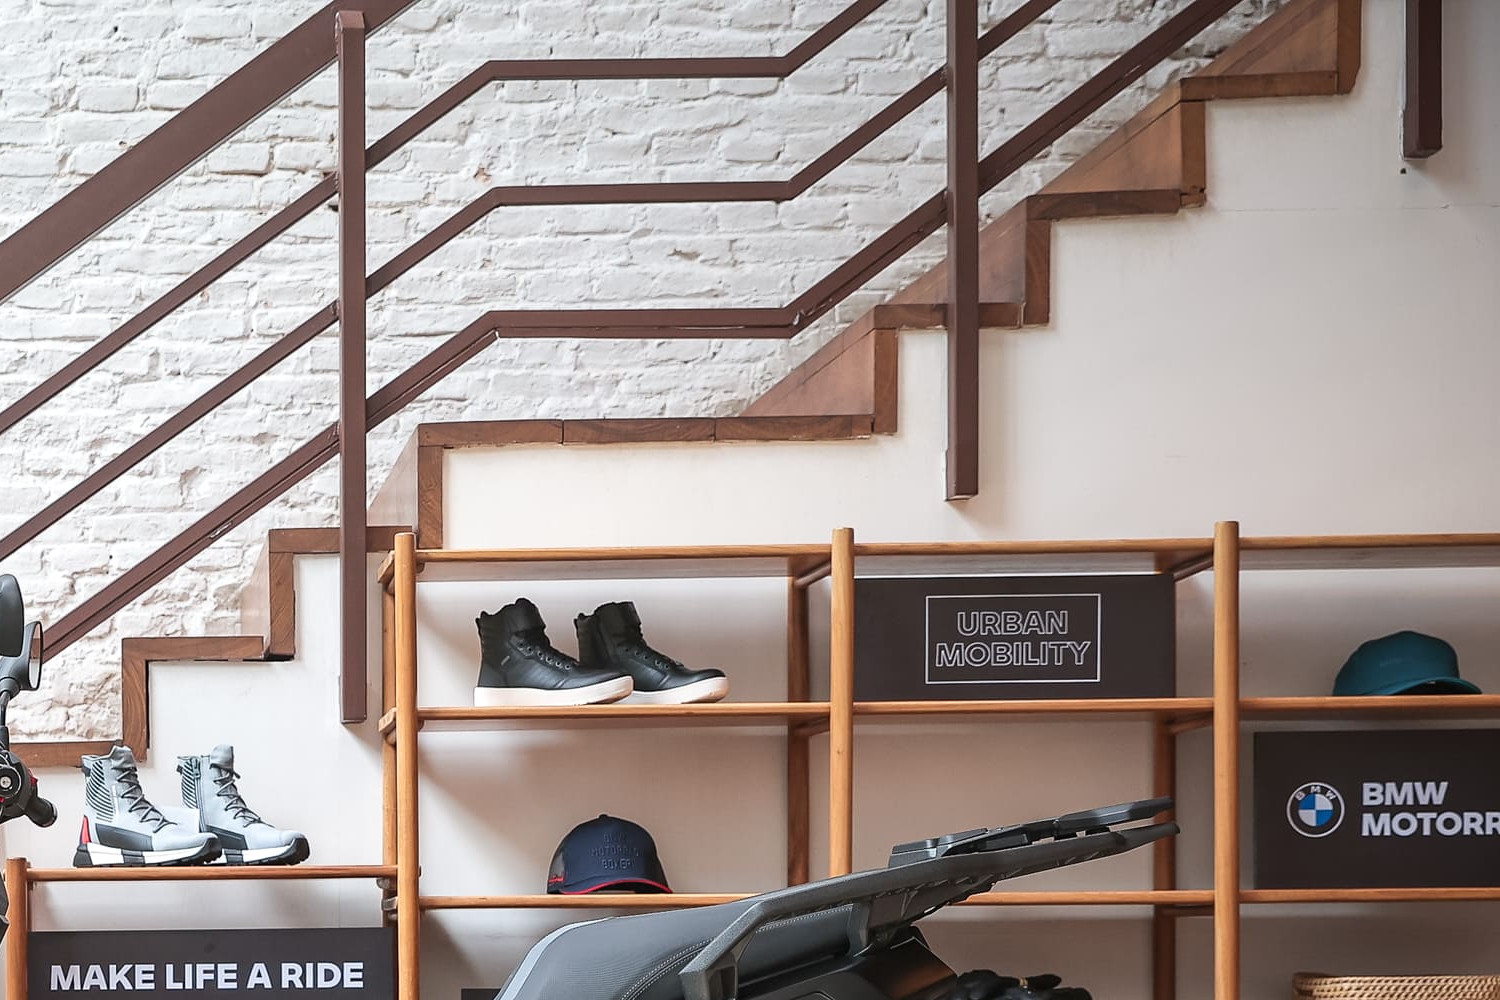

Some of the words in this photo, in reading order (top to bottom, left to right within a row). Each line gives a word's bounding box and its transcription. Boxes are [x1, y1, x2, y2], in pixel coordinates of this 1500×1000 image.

[957, 610, 1069, 636] URBAN
[935, 641, 1091, 666] MOBILITY
[1362, 782, 1449, 805] BMW
[1361, 812, 1500, 836] MOTORR
[50, 964, 156, 990] MAKE
[165, 963, 238, 989] LIFE
[246, 963, 272, 988] A
[281, 962, 364, 988] RIDE
